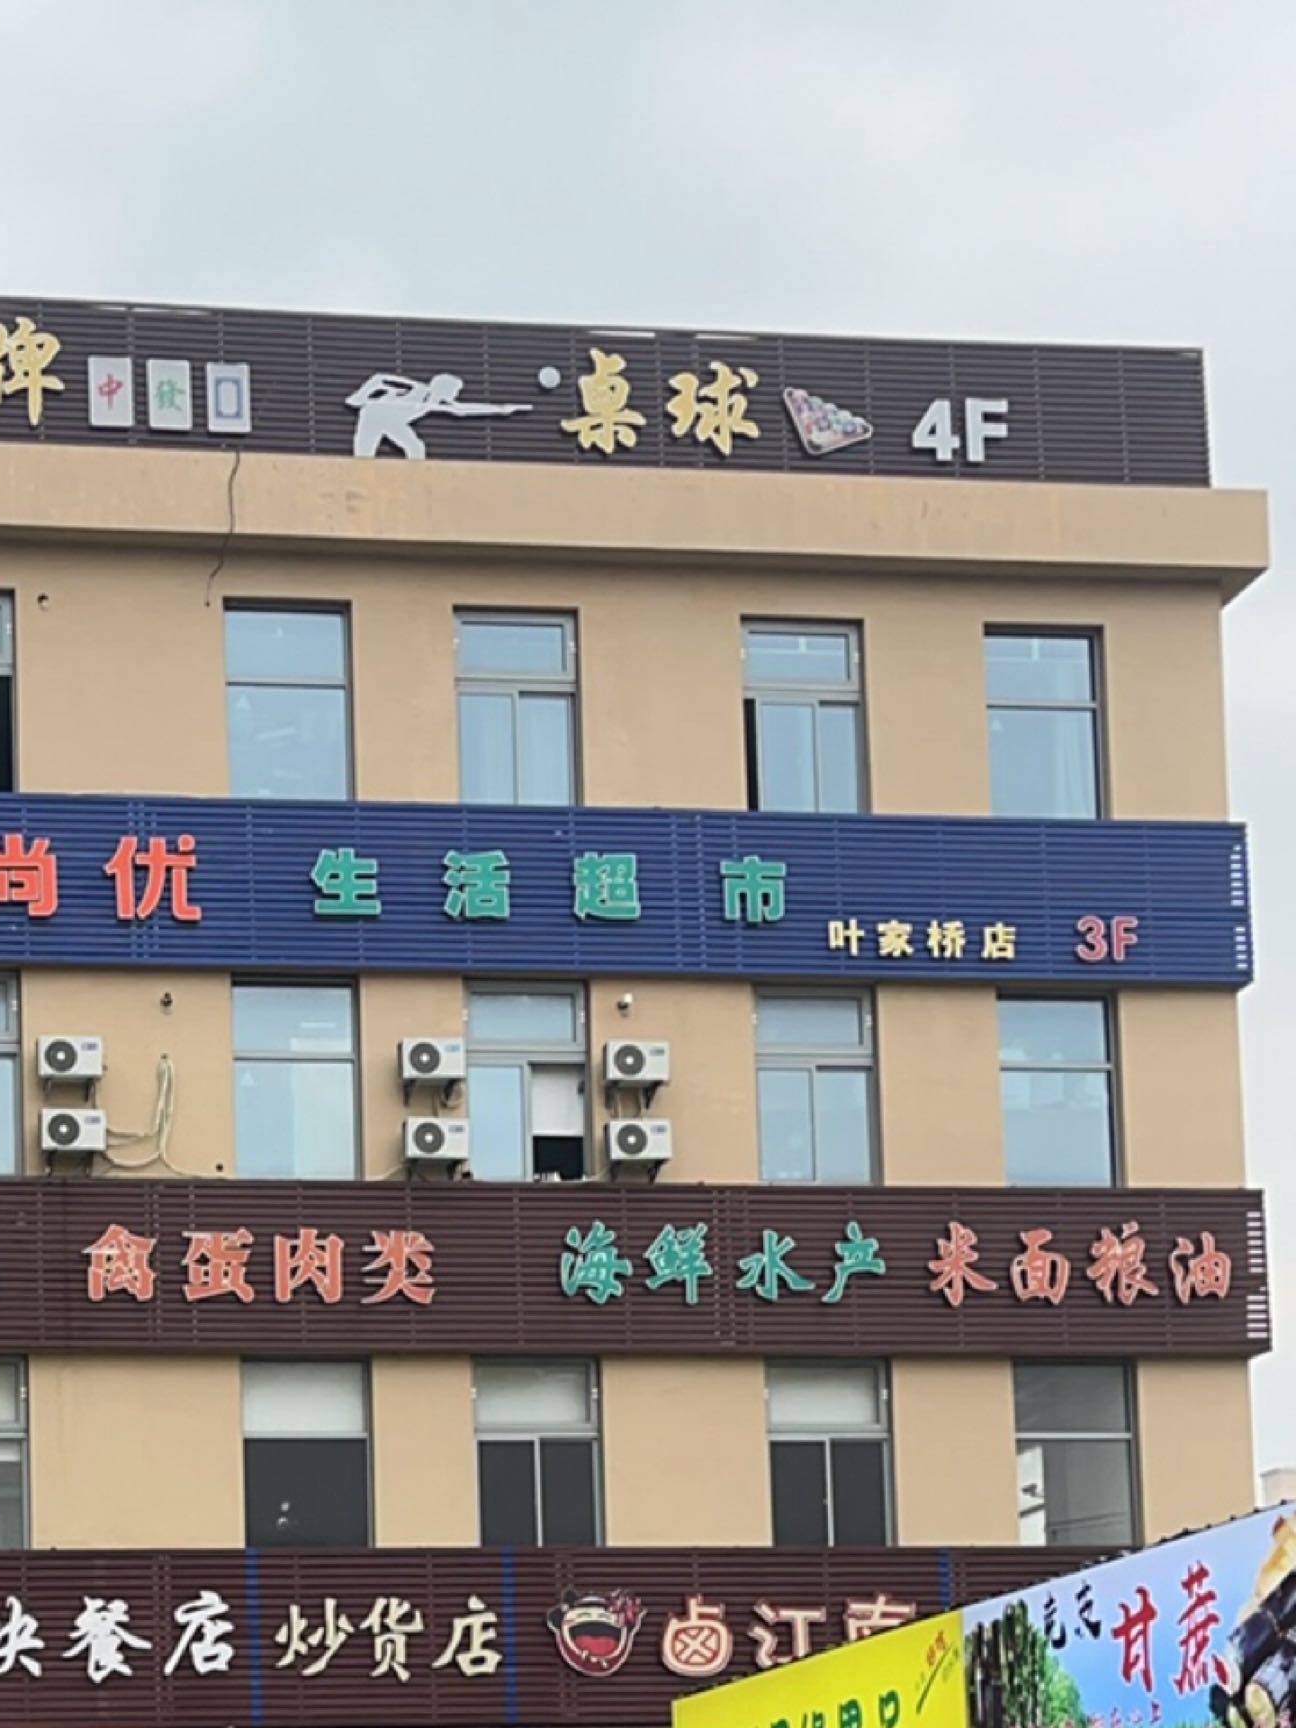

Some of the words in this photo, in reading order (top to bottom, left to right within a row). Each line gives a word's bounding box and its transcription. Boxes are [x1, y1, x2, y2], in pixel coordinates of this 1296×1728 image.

[561, 347, 760, 456] 桌球
[911, 398, 1009, 463] 4F
[311, 848, 788, 924] 生活超市
[828, 918, 1018, 960] 叶家桥店
[1076, 915, 1139, 962] 3F
[82, 1223, 438, 1305] 禽蛋肉类
[559, 1219, 888, 1305] 海鲜水产
[926, 1220, 1235, 1308] 米面粮油
[274, 1594, 503, 1682] 炒货店
